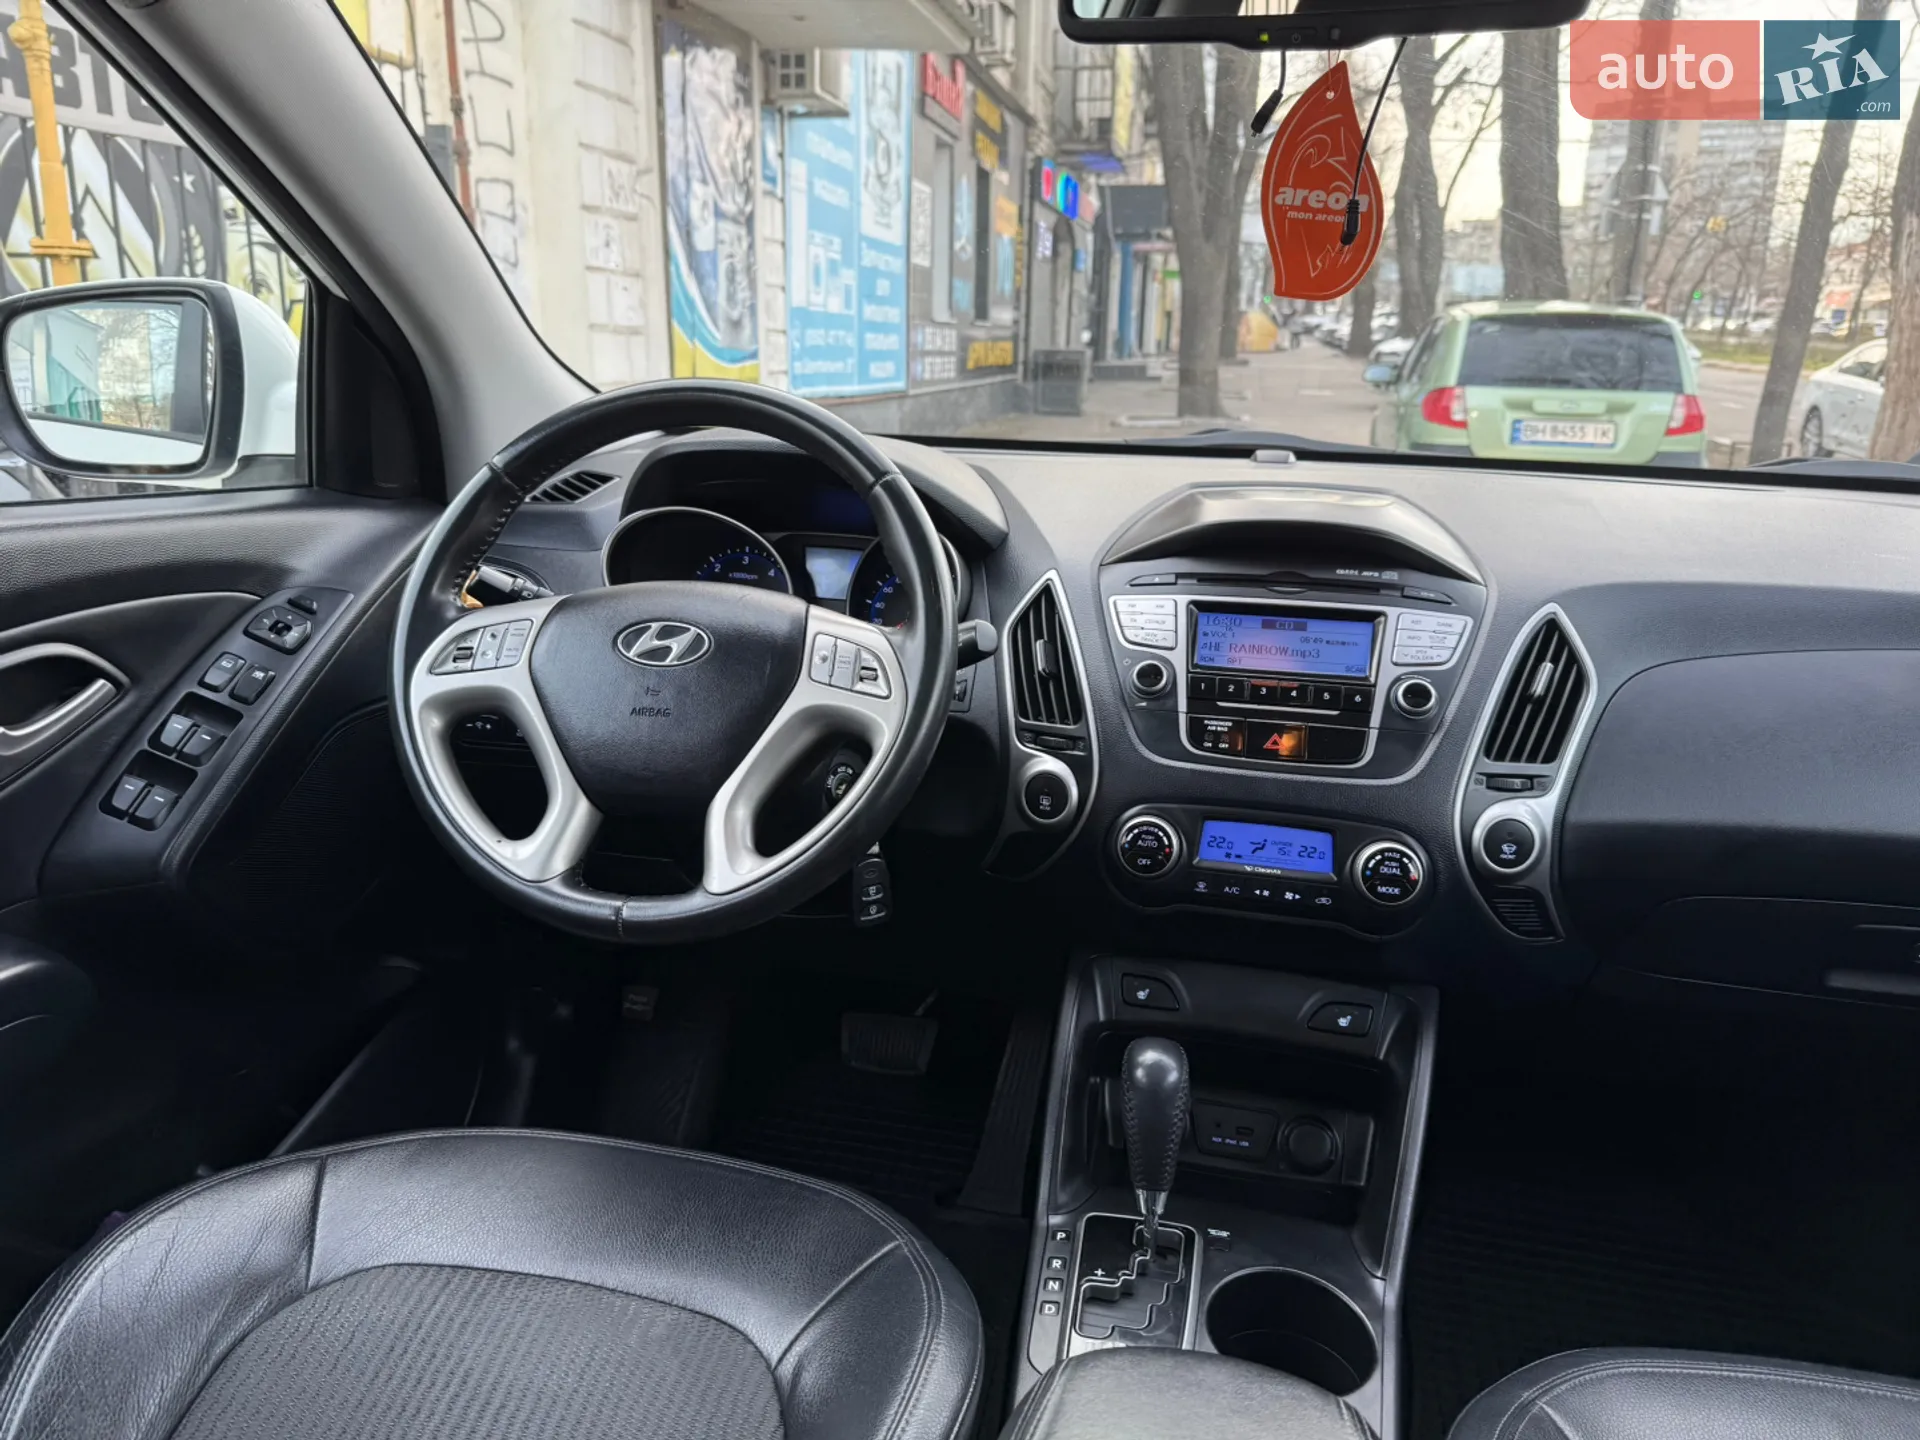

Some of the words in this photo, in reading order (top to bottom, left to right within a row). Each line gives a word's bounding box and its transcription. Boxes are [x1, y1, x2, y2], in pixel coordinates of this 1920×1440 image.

[1287, 210, 1313, 220] mon
[742, 556, 749, 564] 3
[714, 564, 721, 572] 2
[768, 568, 776, 577] 4
[1228, 684, 1235, 692] 2
[1260, 687, 1267, 695] 3
[1323, 692, 1330, 700] 5
[630, 706, 671, 718] AIRBAG
[1137, 839, 1158, 848] AUTO
[1379, 865, 1401, 875] DUAL
[1224, 886, 1240, 895] A/C
[1377, 885, 1401, 895] MODE
[1056, 1232, 1066, 1241] P
[1052, 1258, 1062, 1268] R
[1048, 1280, 1059, 1291] N
[1044, 1304, 1055, 1314] D
